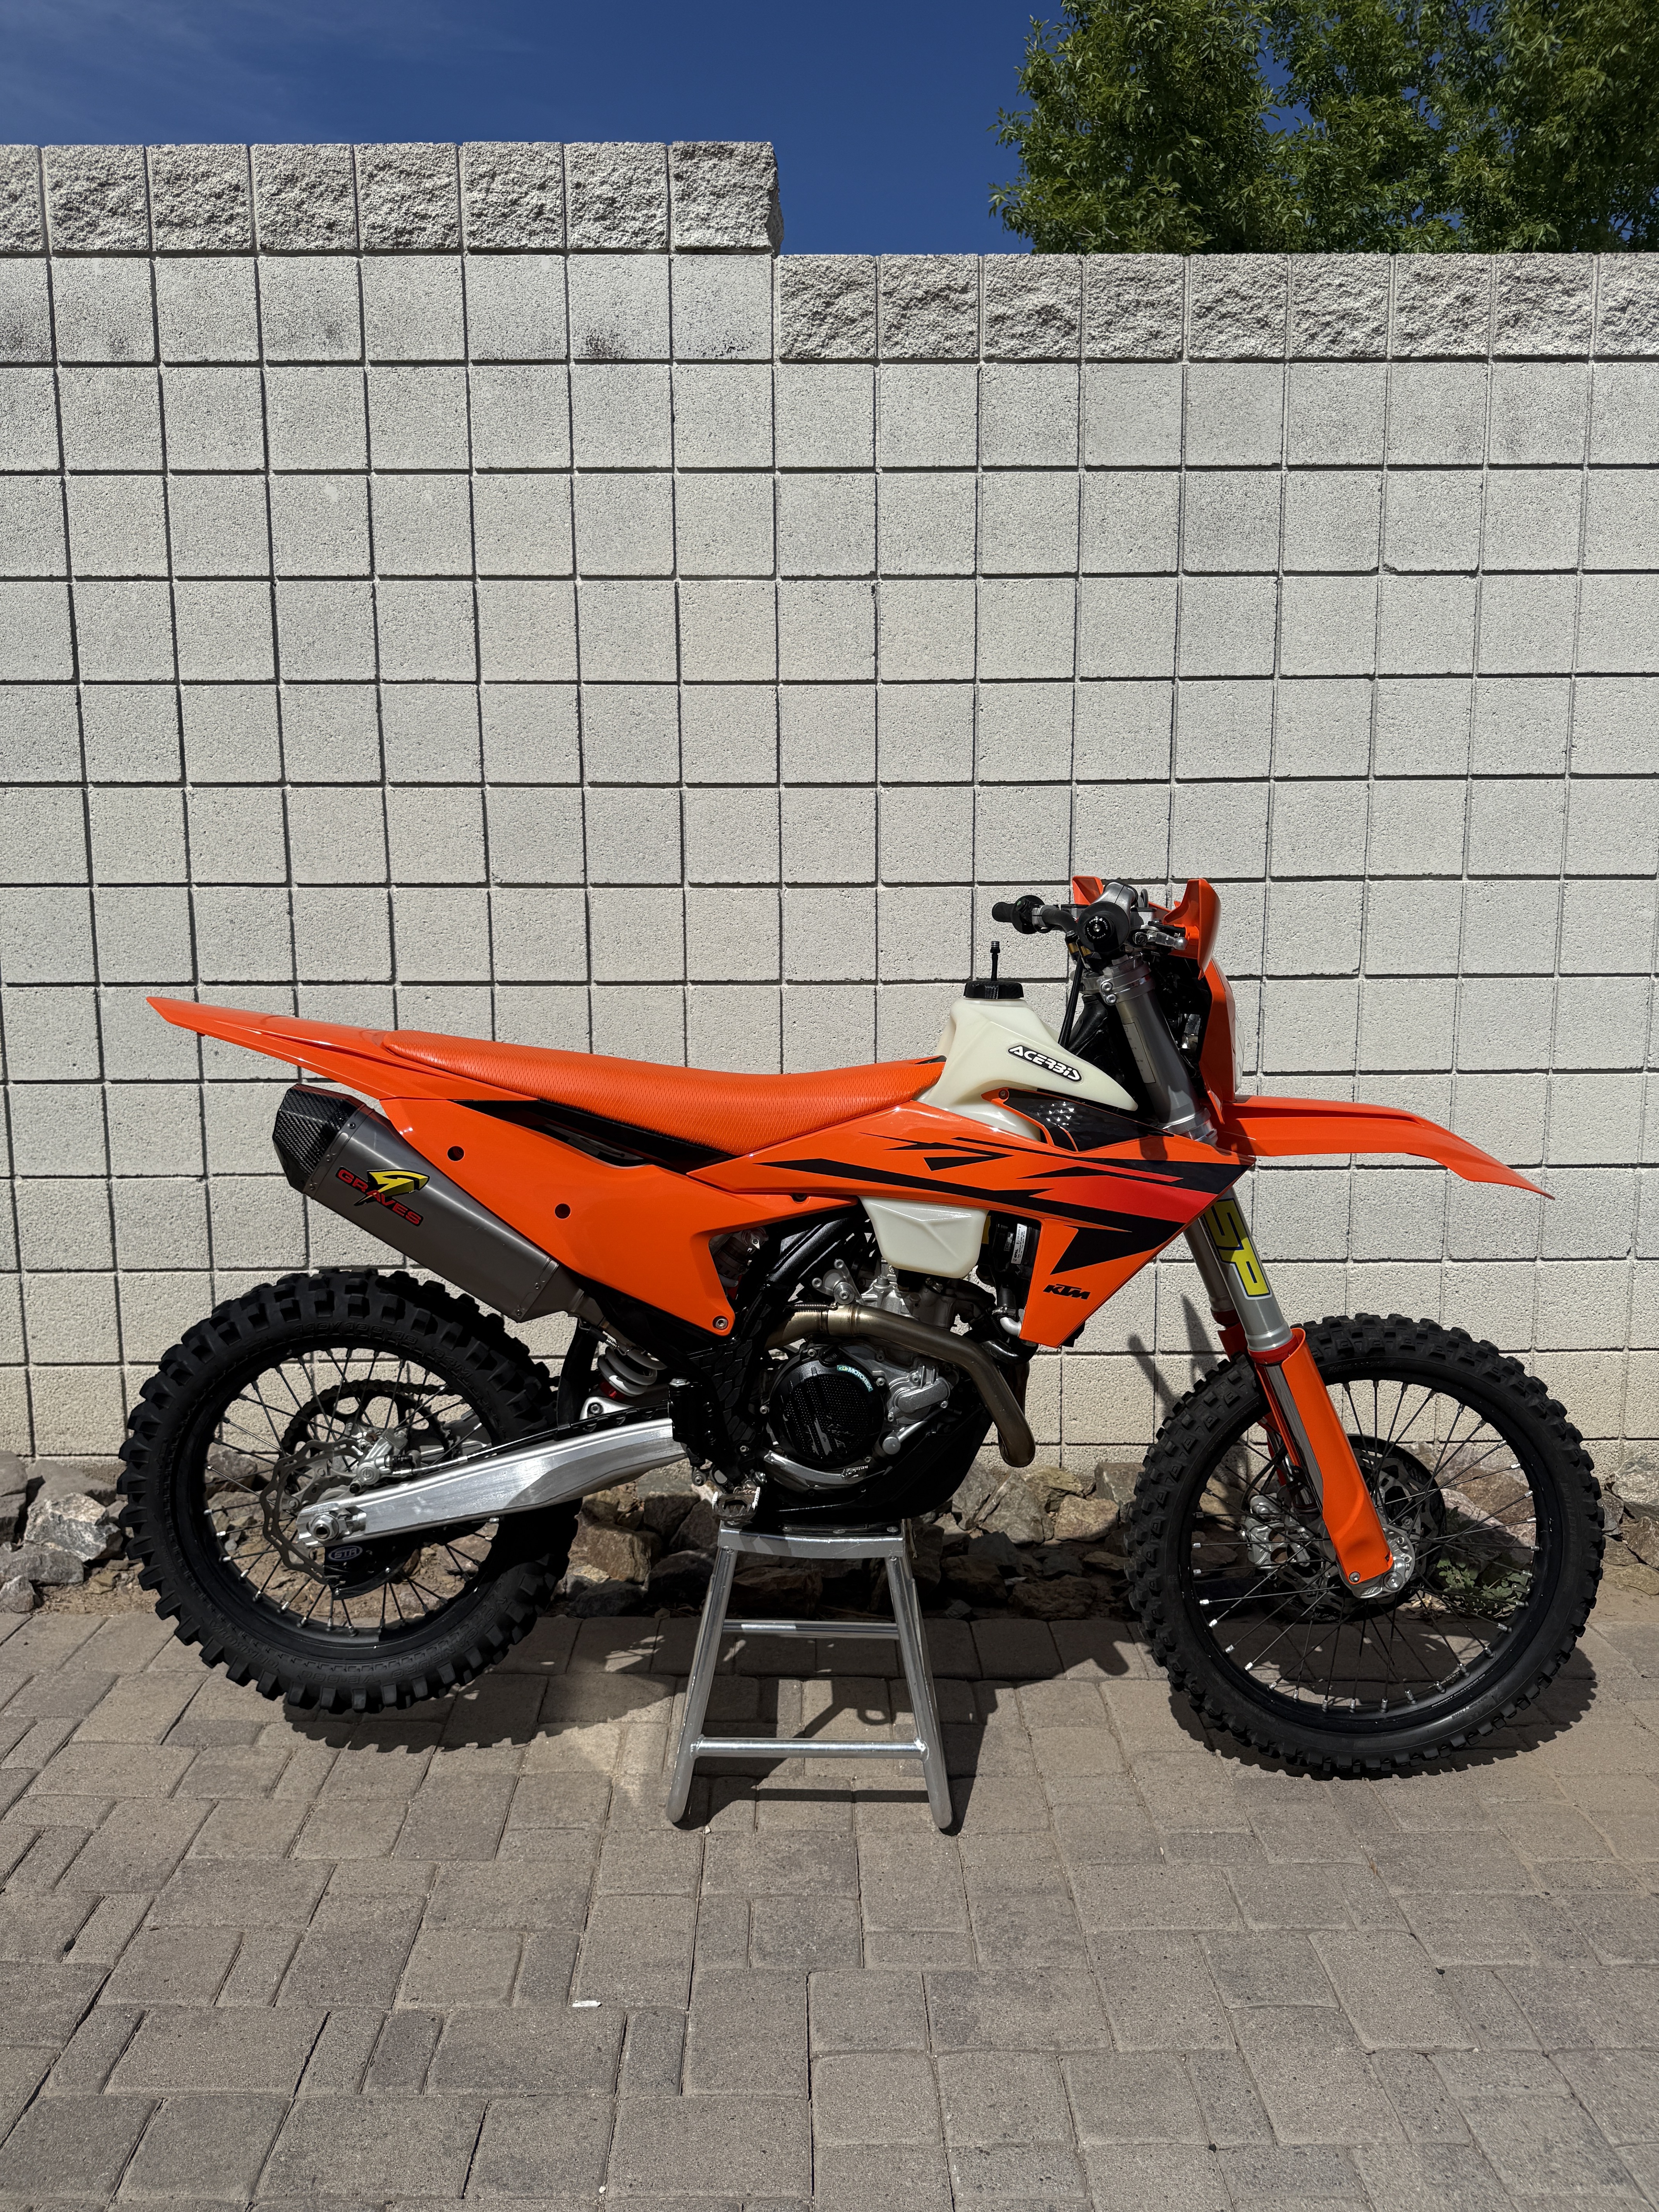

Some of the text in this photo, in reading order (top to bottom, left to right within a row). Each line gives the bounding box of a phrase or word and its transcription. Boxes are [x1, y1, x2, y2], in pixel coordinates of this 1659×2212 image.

[338, 1169, 422, 1224] GRAVES
[1043, 1284, 1091, 1300] KTM
[848, 1367, 873, 1391] MOTOREX
[334, 1548, 357, 1559] STR
